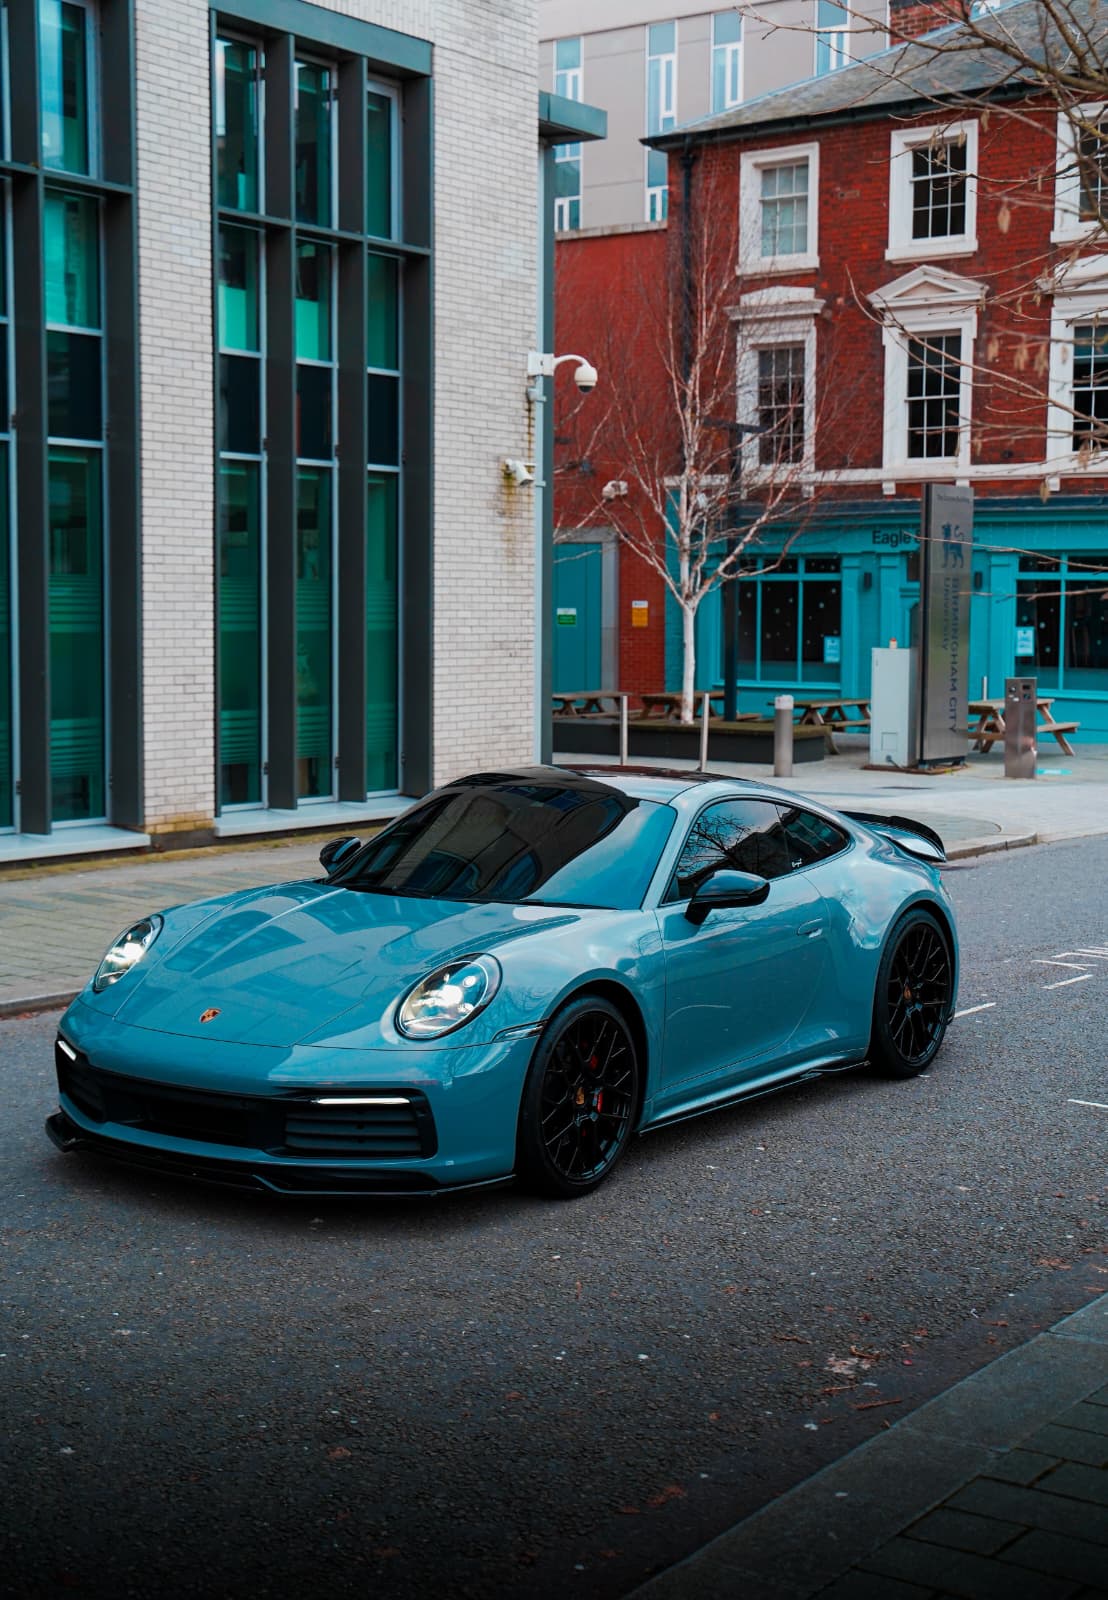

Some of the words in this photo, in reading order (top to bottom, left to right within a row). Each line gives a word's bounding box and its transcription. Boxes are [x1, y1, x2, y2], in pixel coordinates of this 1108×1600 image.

[872, 529, 911, 548] Eagle
[949, 577, 960, 692] BIRMINGHAM
[948, 696, 958, 734] CITY
